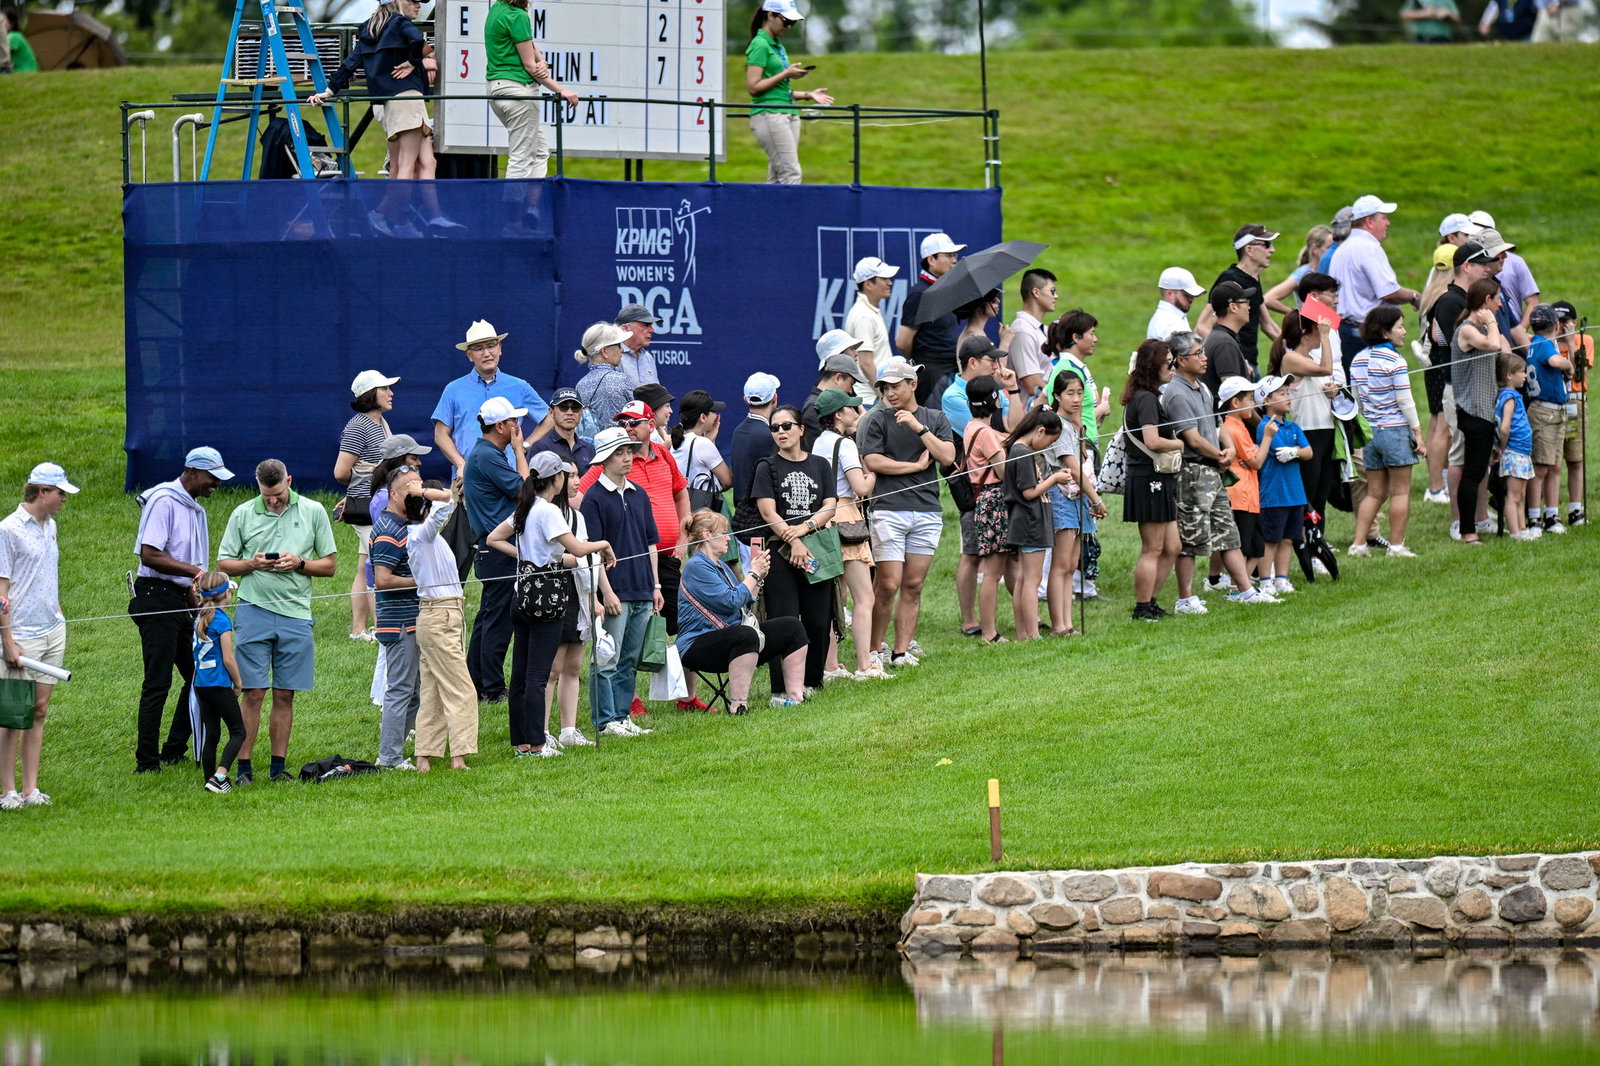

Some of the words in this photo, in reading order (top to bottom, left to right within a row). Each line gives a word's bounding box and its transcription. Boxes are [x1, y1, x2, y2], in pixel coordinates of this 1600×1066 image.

[460, 6, 469, 36] E
[658, 14, 667, 42] 2
[695, 16, 704, 44] 3
[460, 49, 469, 79] 3
[545, 52, 581, 82] HLIN
[590, 51, 598, 81] L
[657, 56, 666, 85] 7
[696, 56, 704, 84] 3
[585, 94, 607, 124] AT
[696, 96, 705, 125] 2
[615, 227, 671, 256] KPMG
[616, 265, 675, 282] WOMEN'S
[651, 350, 692, 365] TUSROL
